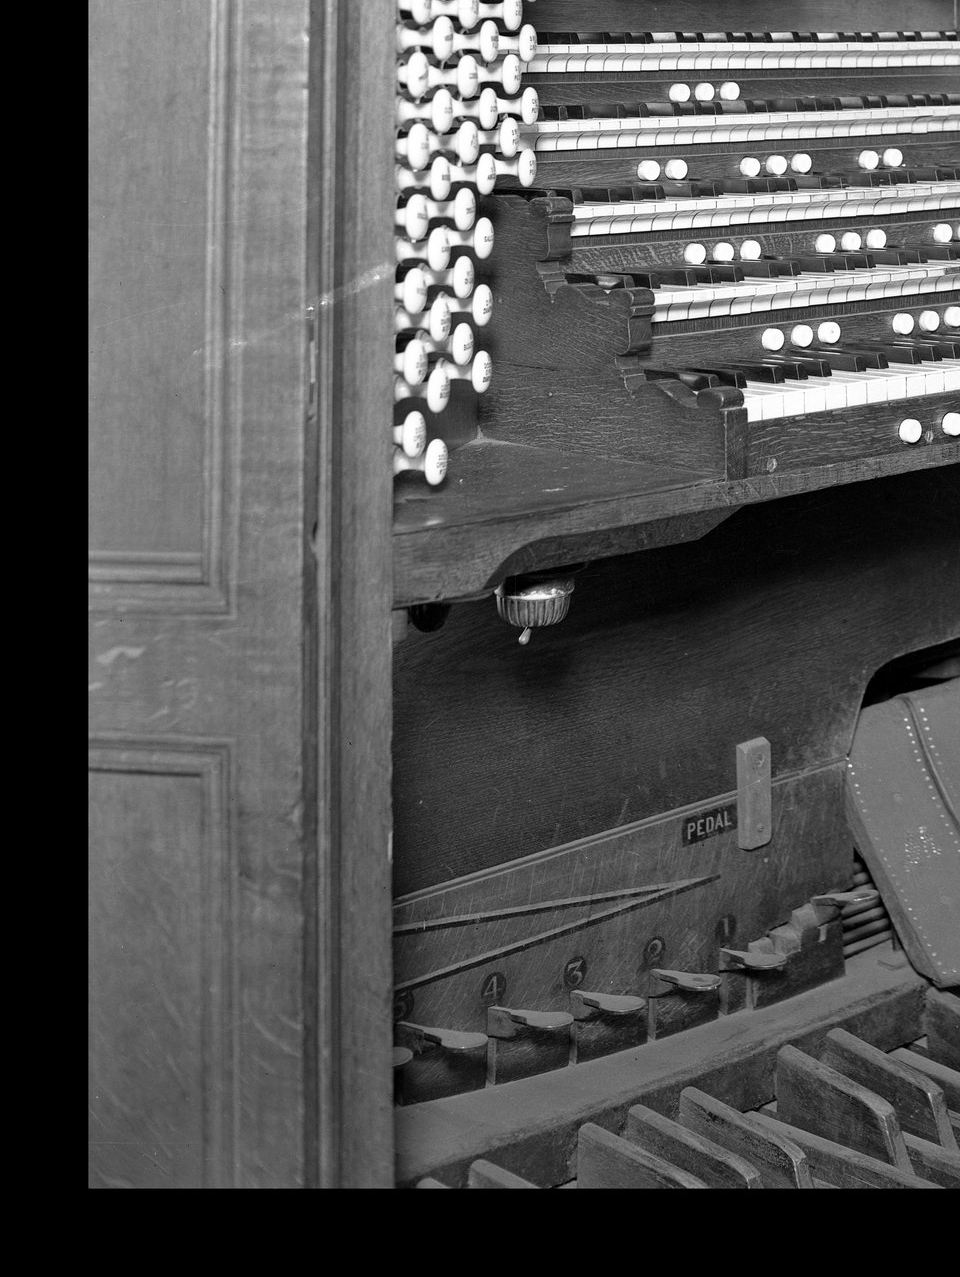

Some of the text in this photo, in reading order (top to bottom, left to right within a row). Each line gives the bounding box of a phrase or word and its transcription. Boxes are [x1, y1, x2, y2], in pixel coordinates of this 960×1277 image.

[687, 810, 733, 840] PEDAL
[647, 938, 664, 965] 2
[483, 974, 503, 999] 4
[566, 959, 584, 987] 3
